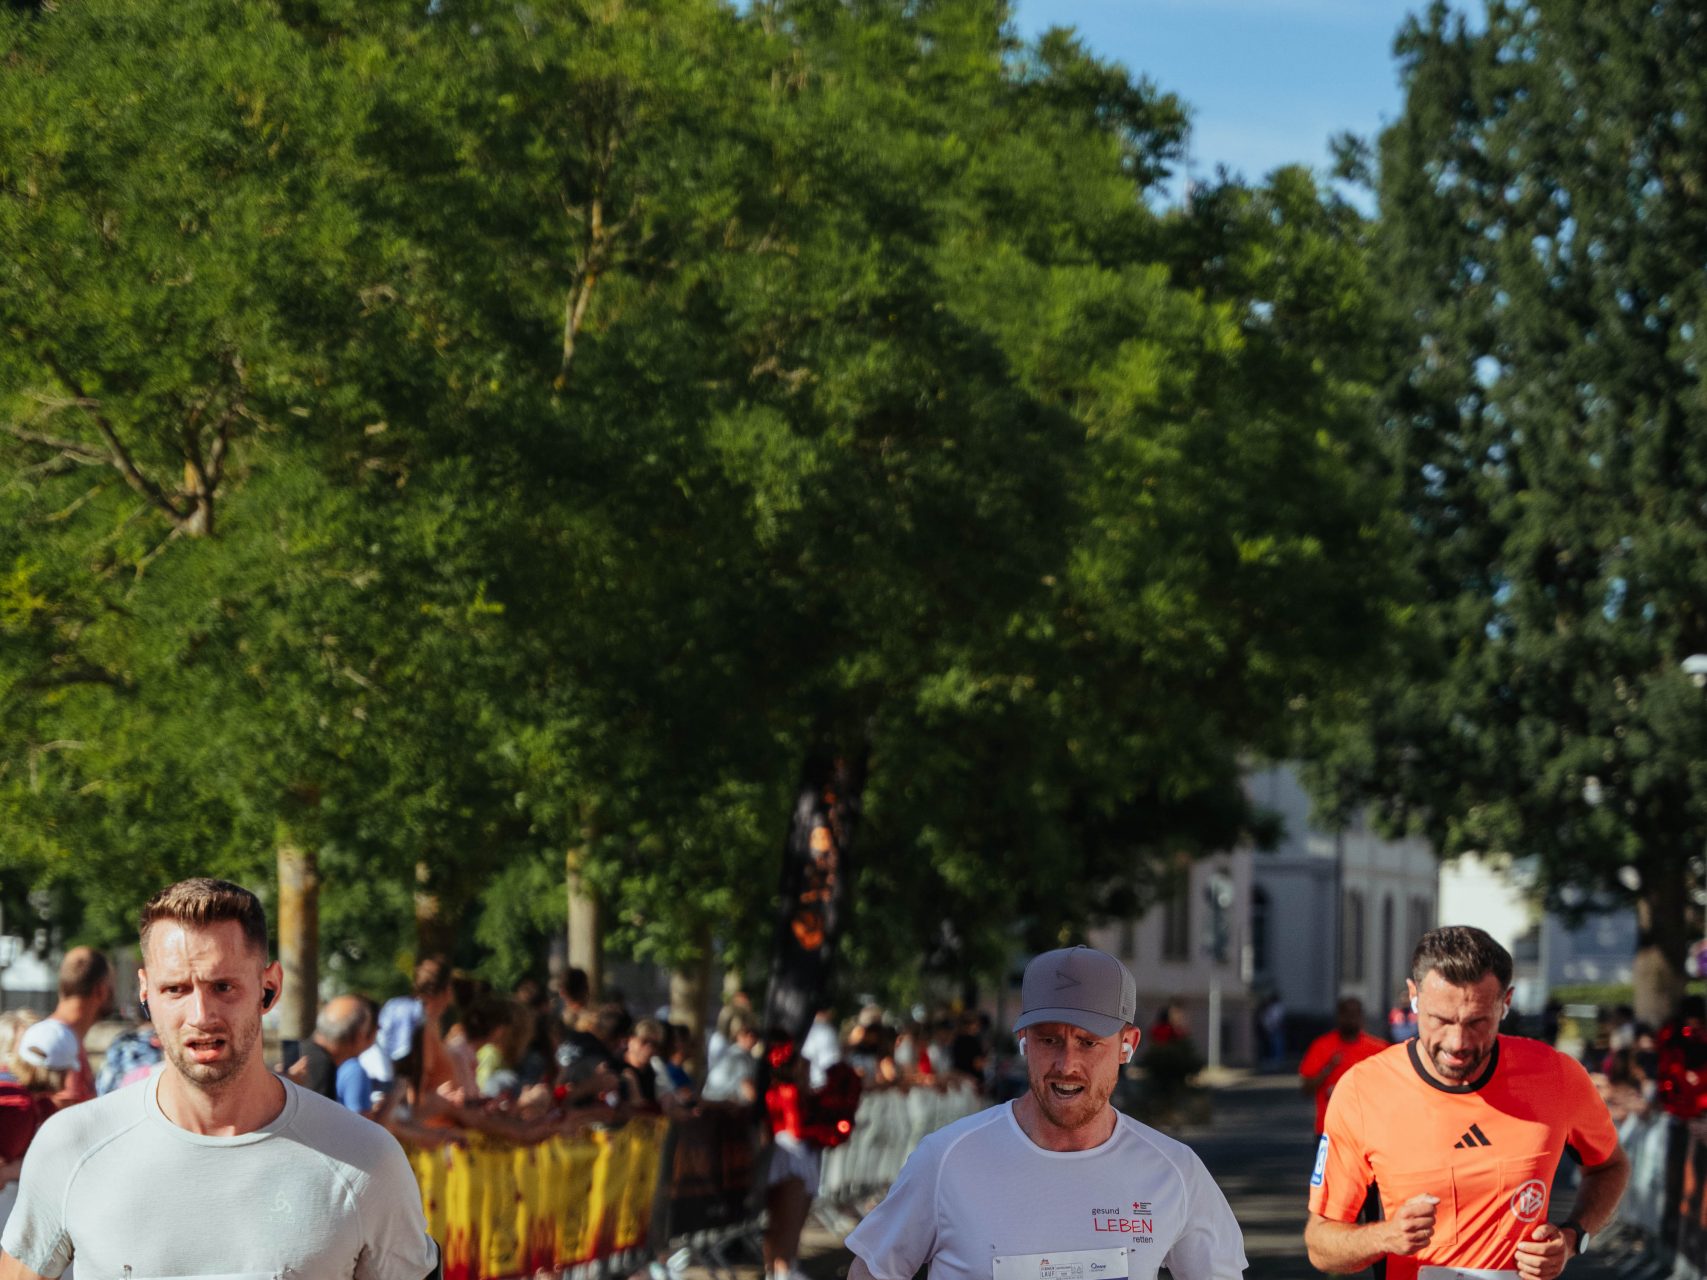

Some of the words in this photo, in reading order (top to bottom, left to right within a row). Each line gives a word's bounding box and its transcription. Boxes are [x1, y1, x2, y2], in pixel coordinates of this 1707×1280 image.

[1091, 1207, 1120, 1216] gesund
[1094, 1217, 1153, 1234] LEBEN
[1132, 1236, 1154, 1244] retten
